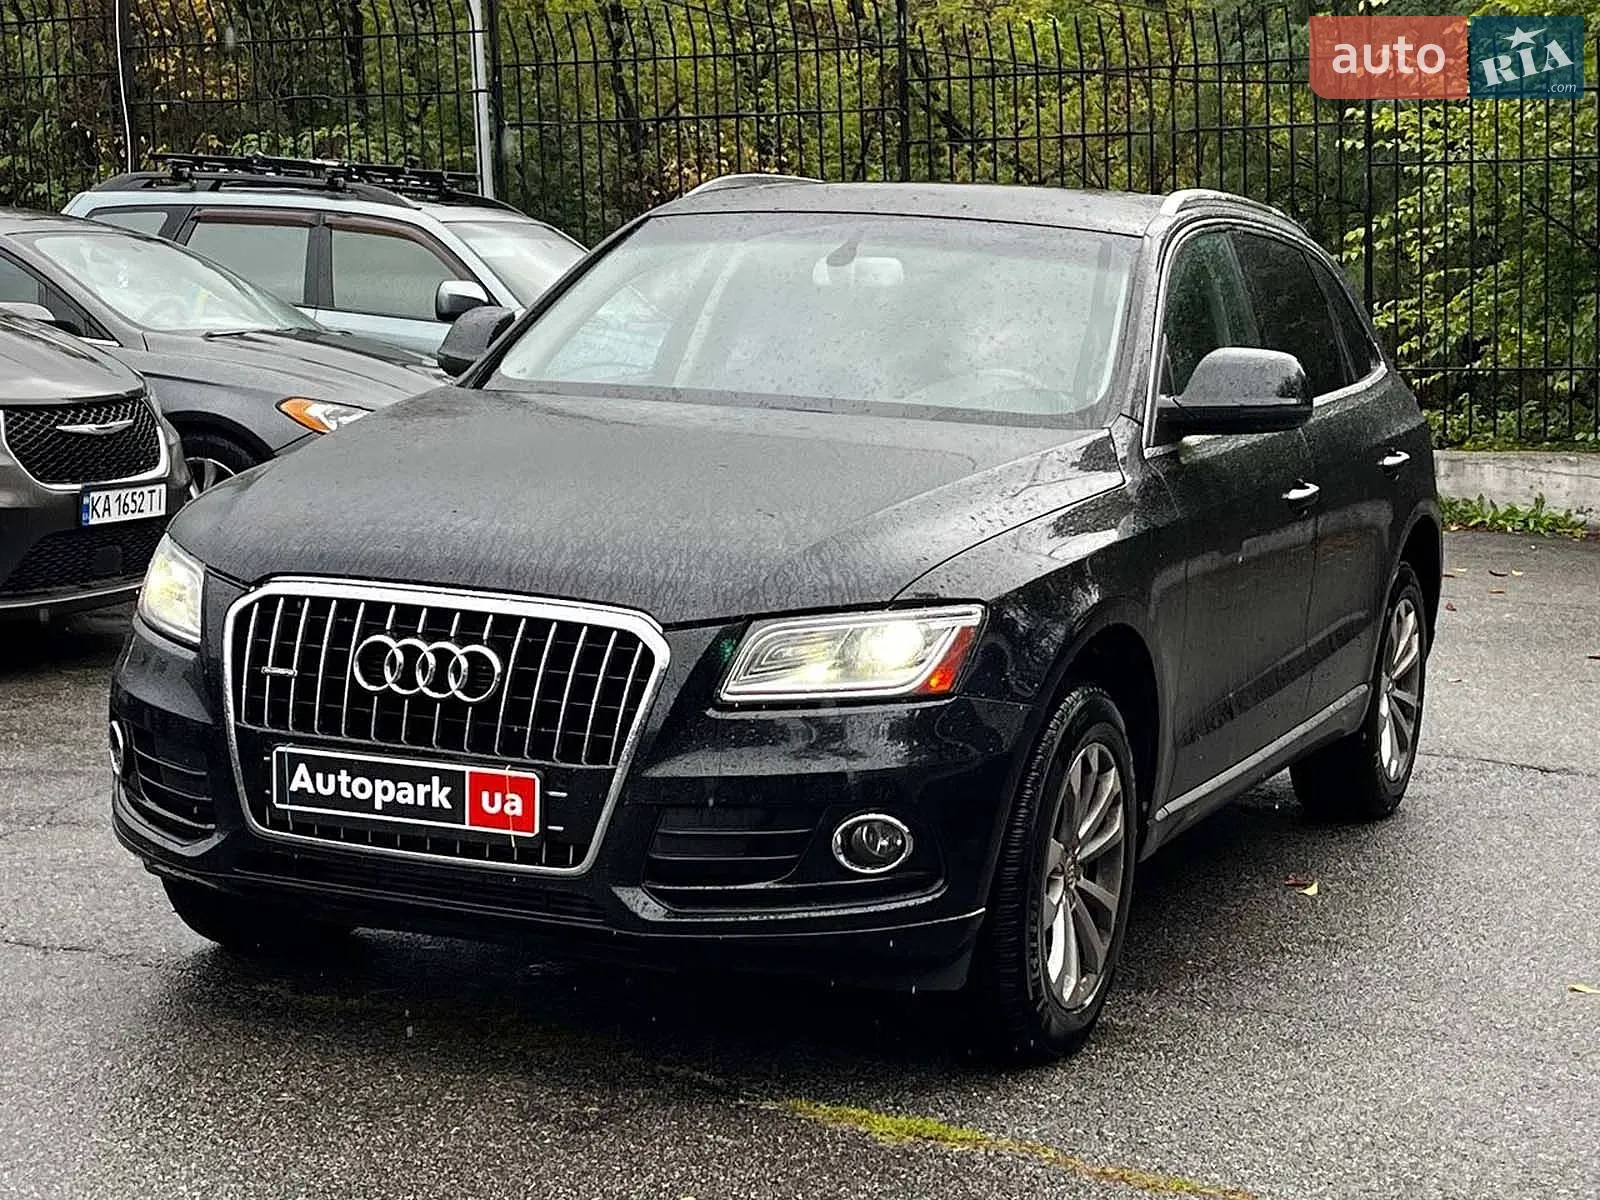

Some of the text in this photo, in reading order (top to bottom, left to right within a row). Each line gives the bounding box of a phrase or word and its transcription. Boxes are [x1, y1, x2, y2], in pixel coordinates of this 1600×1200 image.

[91, 489, 162, 518] KA 1652 TI
[289, 762, 523, 817] Autopark ua
